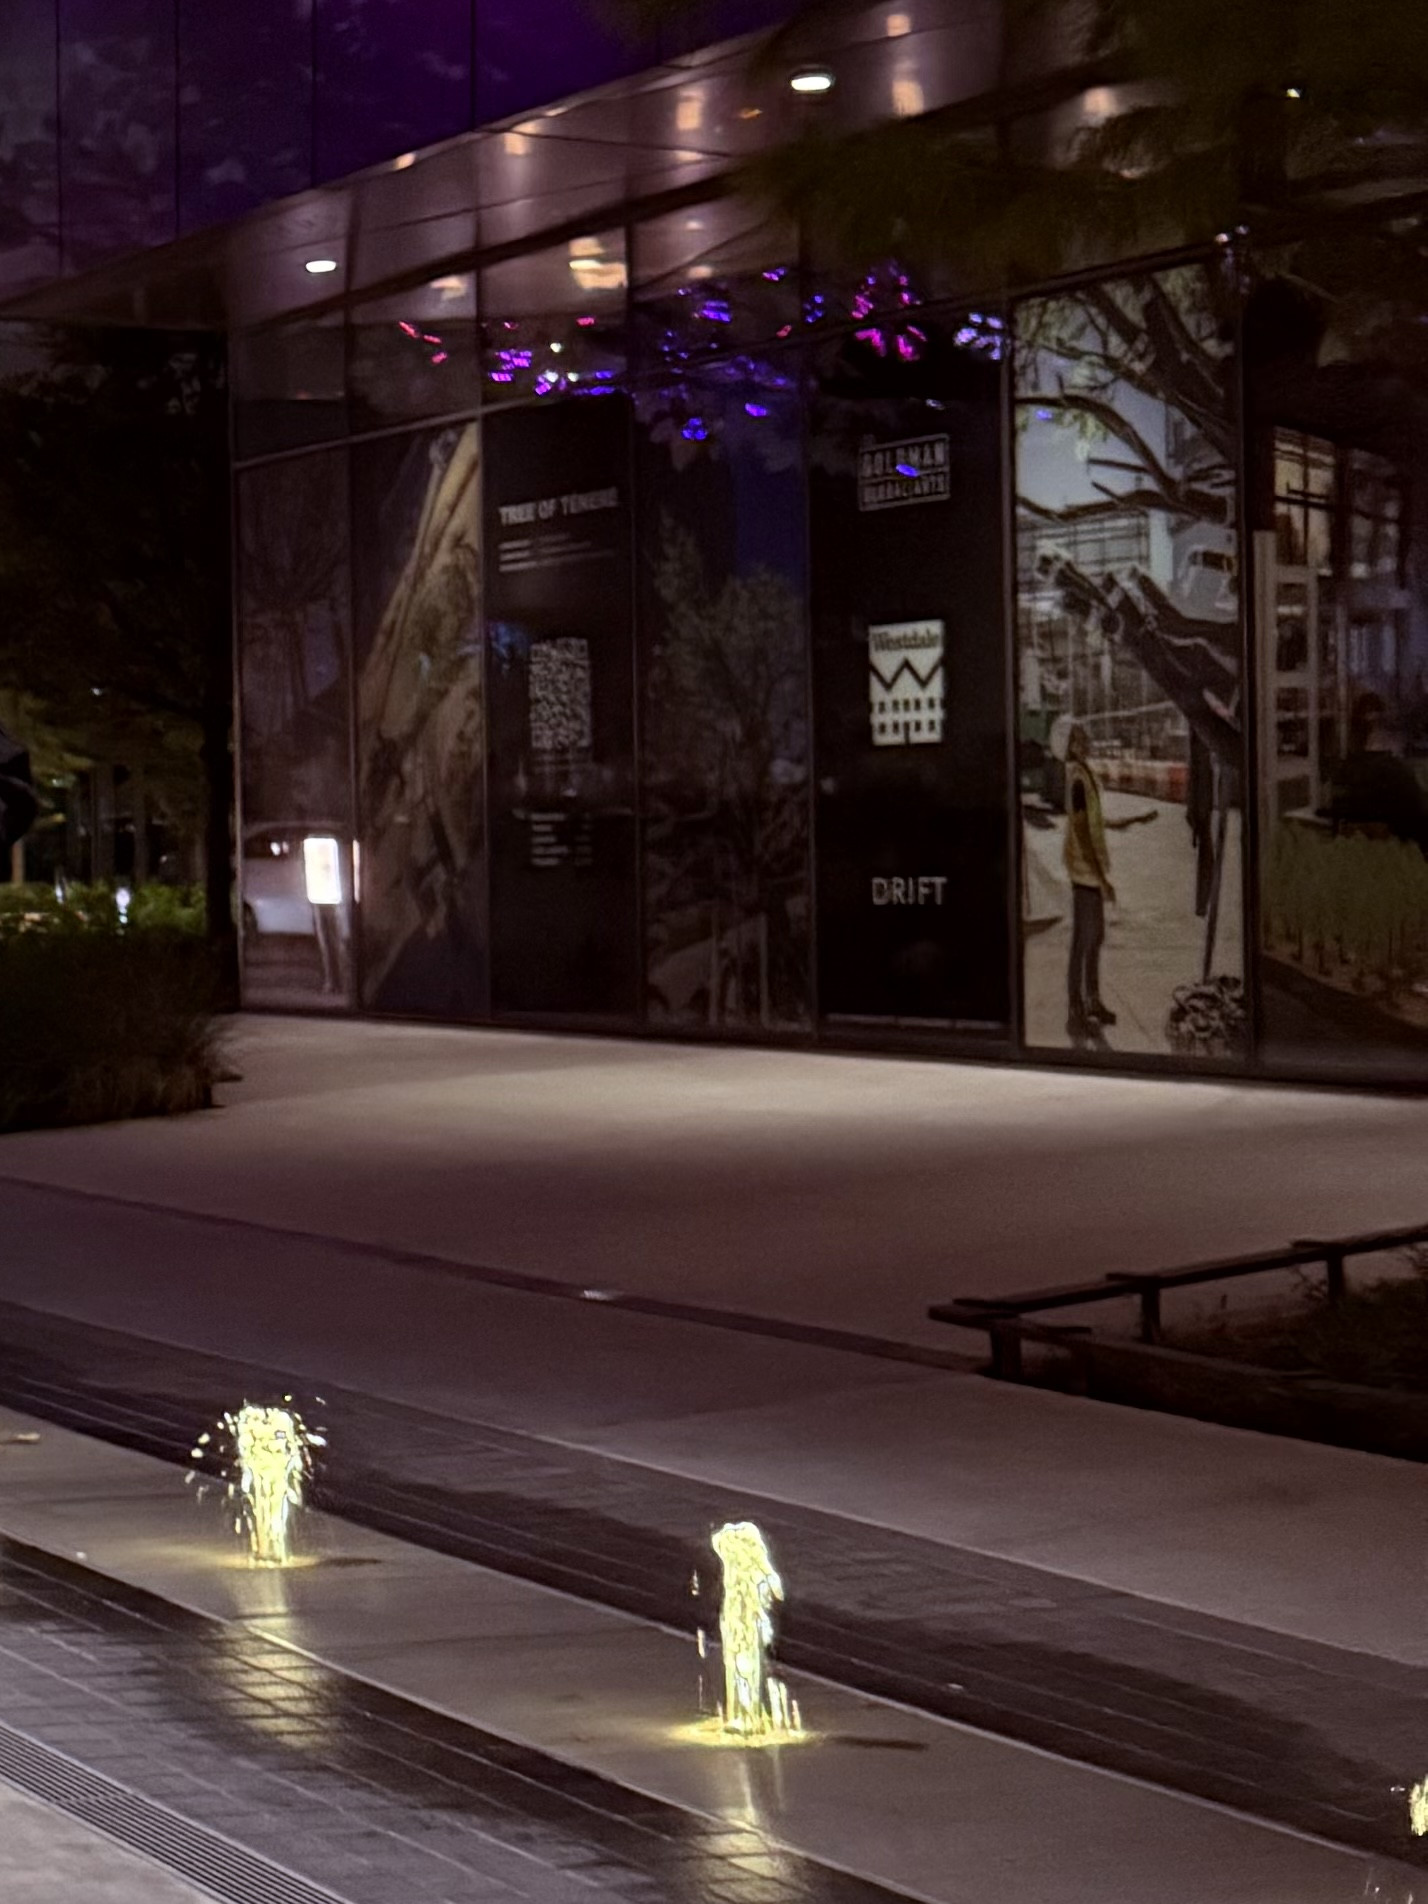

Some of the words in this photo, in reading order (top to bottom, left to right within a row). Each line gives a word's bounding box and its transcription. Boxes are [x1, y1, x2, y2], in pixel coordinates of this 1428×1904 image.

[498, 501, 536, 527] TREE
[537, 497, 557, 520] OF
[871, 875, 948, 906] DRIFT
